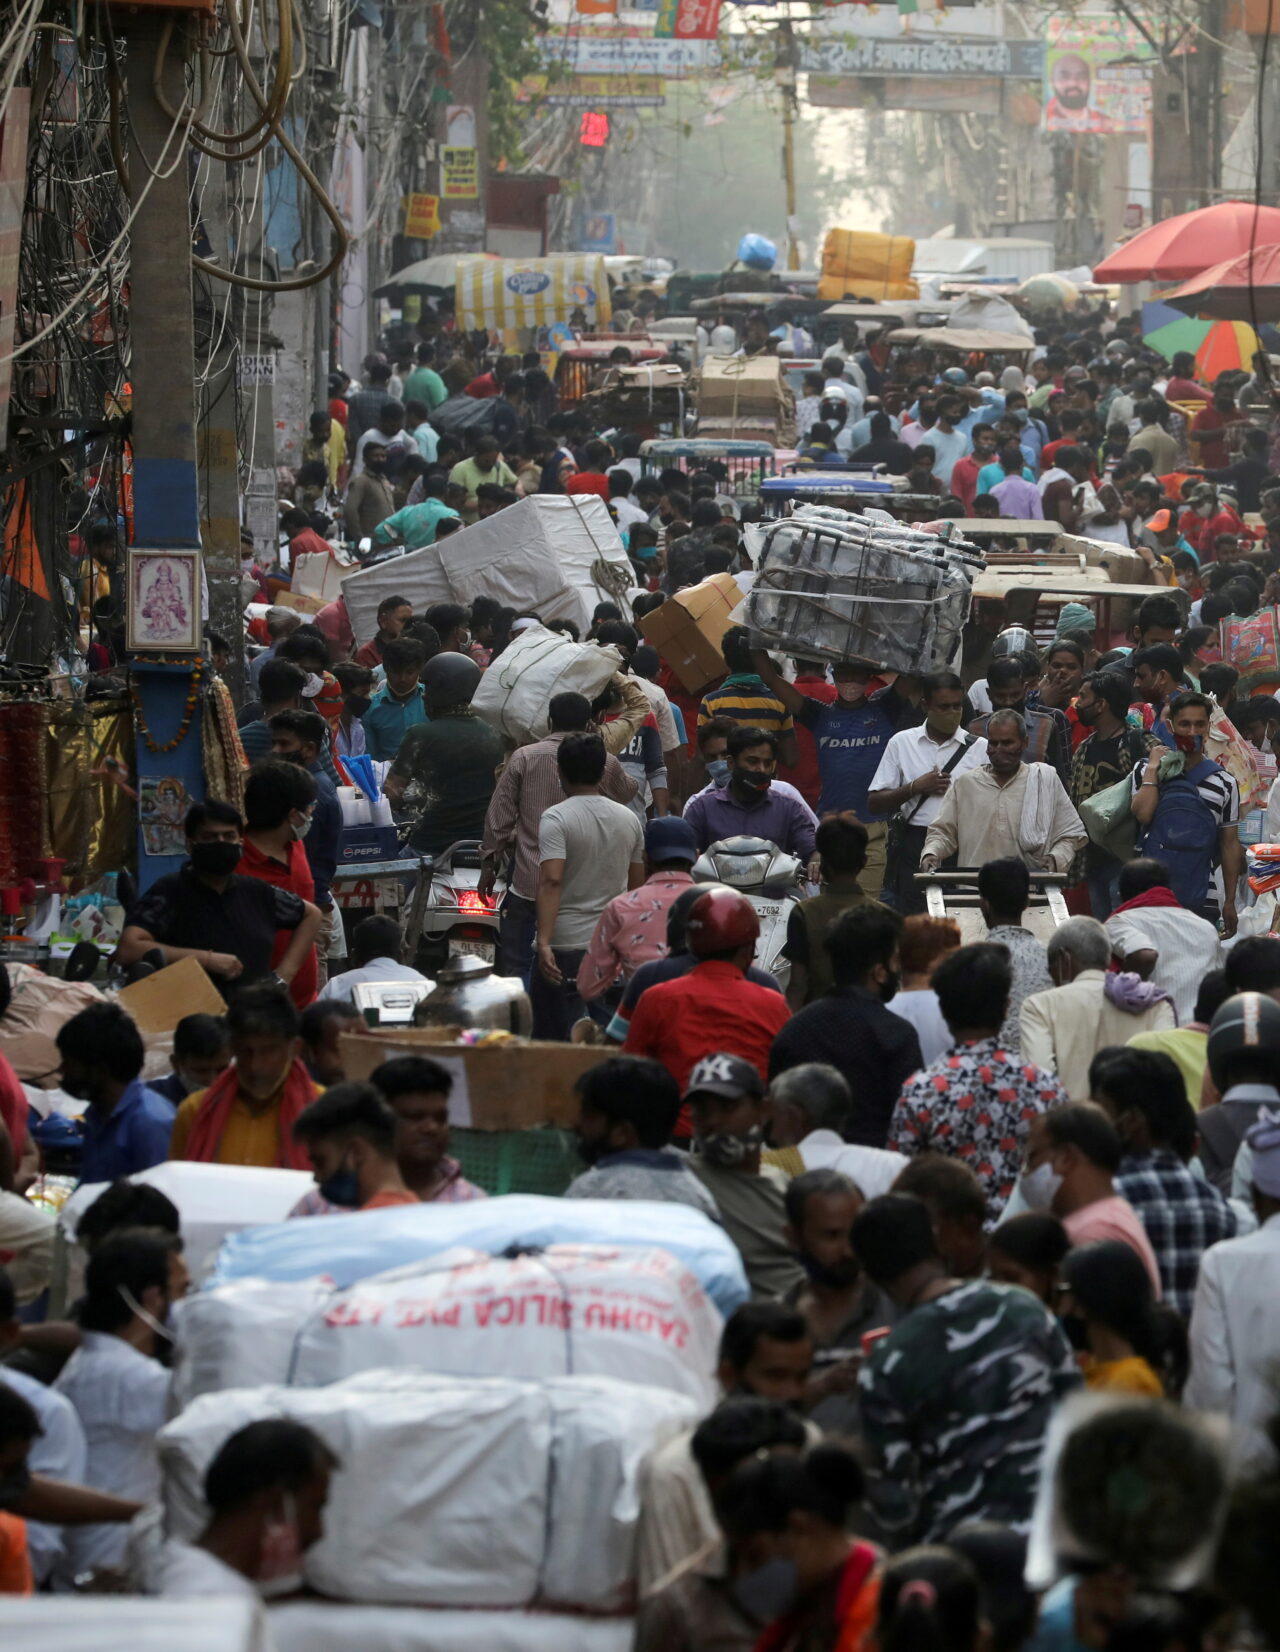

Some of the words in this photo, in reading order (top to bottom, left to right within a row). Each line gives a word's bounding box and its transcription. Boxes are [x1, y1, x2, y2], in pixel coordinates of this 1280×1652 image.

[239, 356, 273, 366] OME
[239, 366, 273, 376] OAN
[829, 735, 880, 748] DAIKIN
[353, 847, 383, 856] PEPSI
